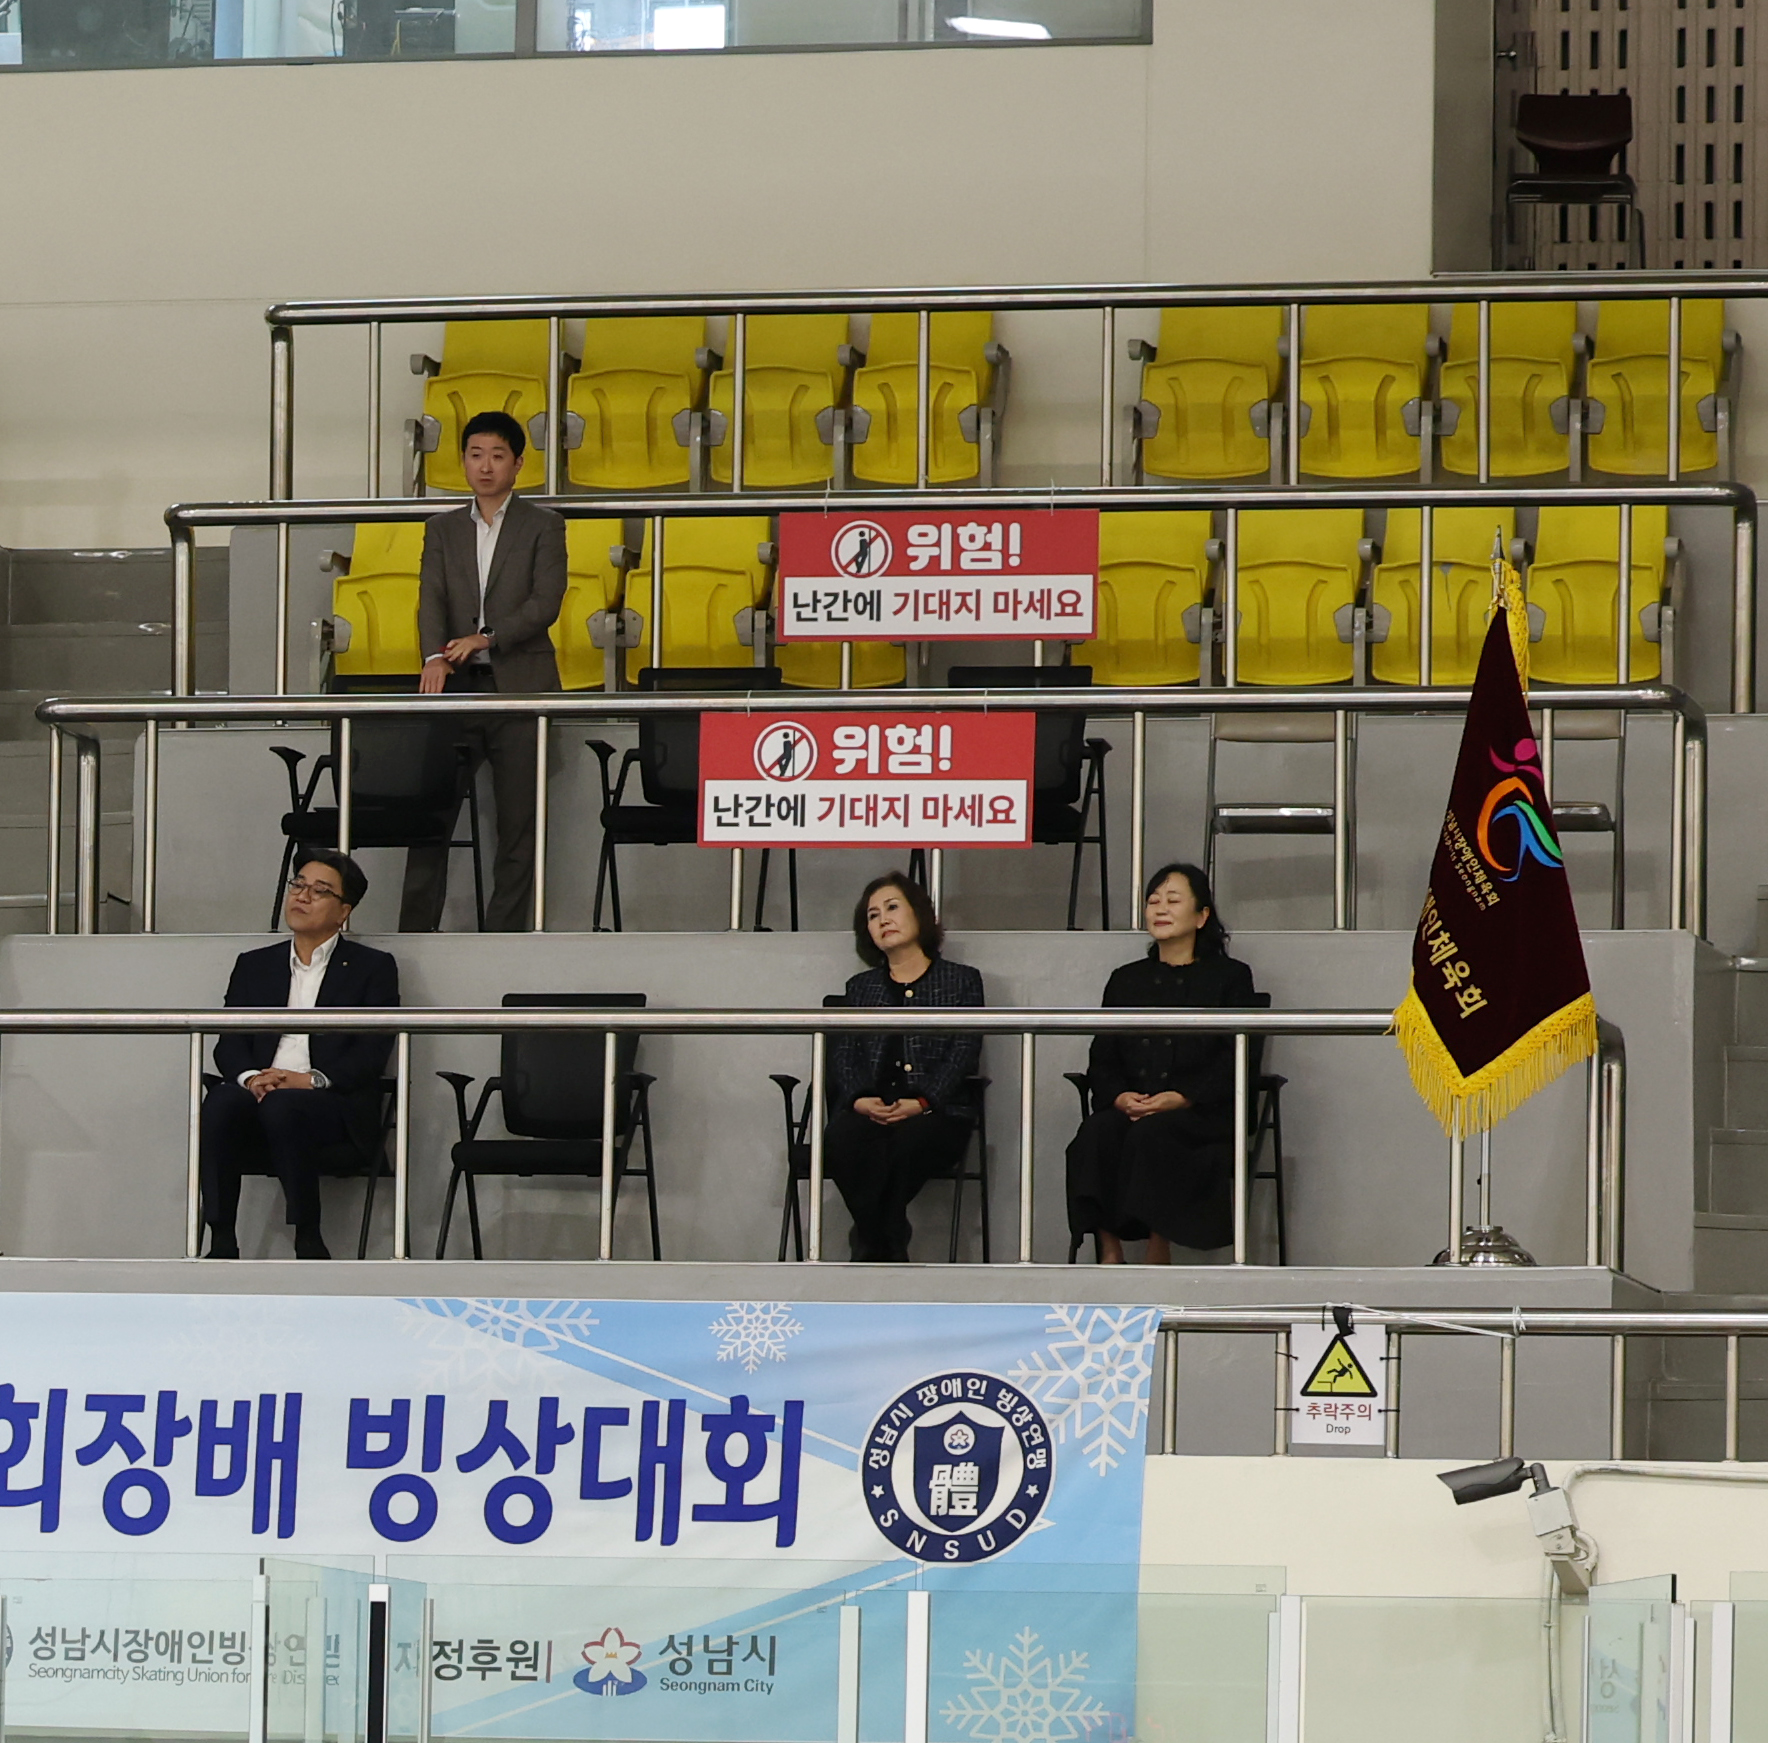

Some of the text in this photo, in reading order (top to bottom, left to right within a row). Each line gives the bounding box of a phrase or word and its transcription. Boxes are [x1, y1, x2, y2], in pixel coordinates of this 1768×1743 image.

[907, 522, 1021, 570] 위험!
[792, 588, 1084, 622] 난간에 기대지 마세요
[832, 724, 952, 774] 위험!
[713, 793, 1017, 828] 난간에 기대지 마세요
[868, 1377, 1047, 1470] 성남시 장애인 빙상연맹
[1306, 1402, 1372, 1421] 추락주의
[1326, 1424, 1351, 1434] Drop
[345, 1394, 807, 1549] 빙상대회
[928, 1461, 980, 1516] 體
[659, 1634, 777, 1676] 성남시
[28, 1662, 129, 1684] Seongnamcity
[131, 1665, 184, 1687] Skating
[187, 1666, 229, 1684] Union
[231, 1668, 250, 1684] for
[659, 1677, 775, 1695] Seongnam City
